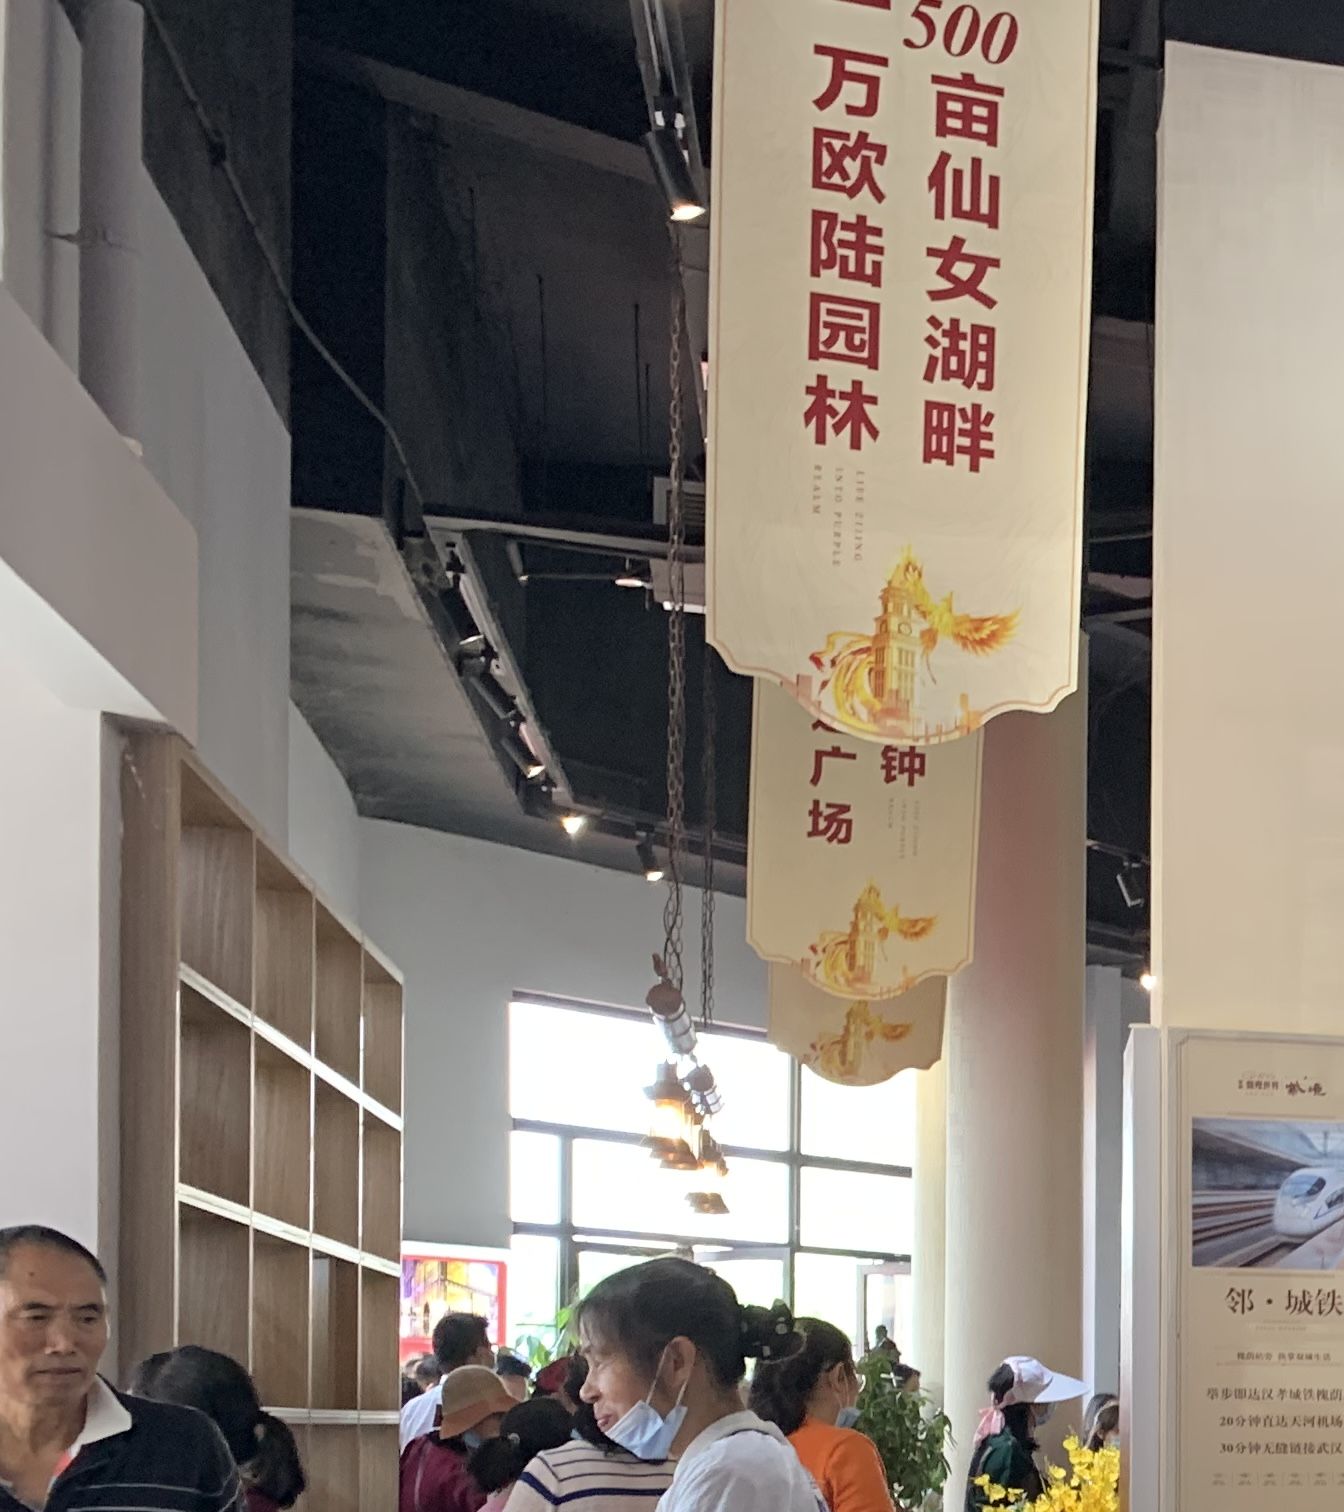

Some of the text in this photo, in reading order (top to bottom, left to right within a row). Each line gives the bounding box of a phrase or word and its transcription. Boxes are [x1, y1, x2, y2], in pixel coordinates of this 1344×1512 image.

[902, 0, 1018, 474] 500亩仙女湖畔
[806, 715, 862, 845] 广场
[880, 744, 926, 787] 钟
[1225, 1287, 1344, 1317] 邻·城铁
